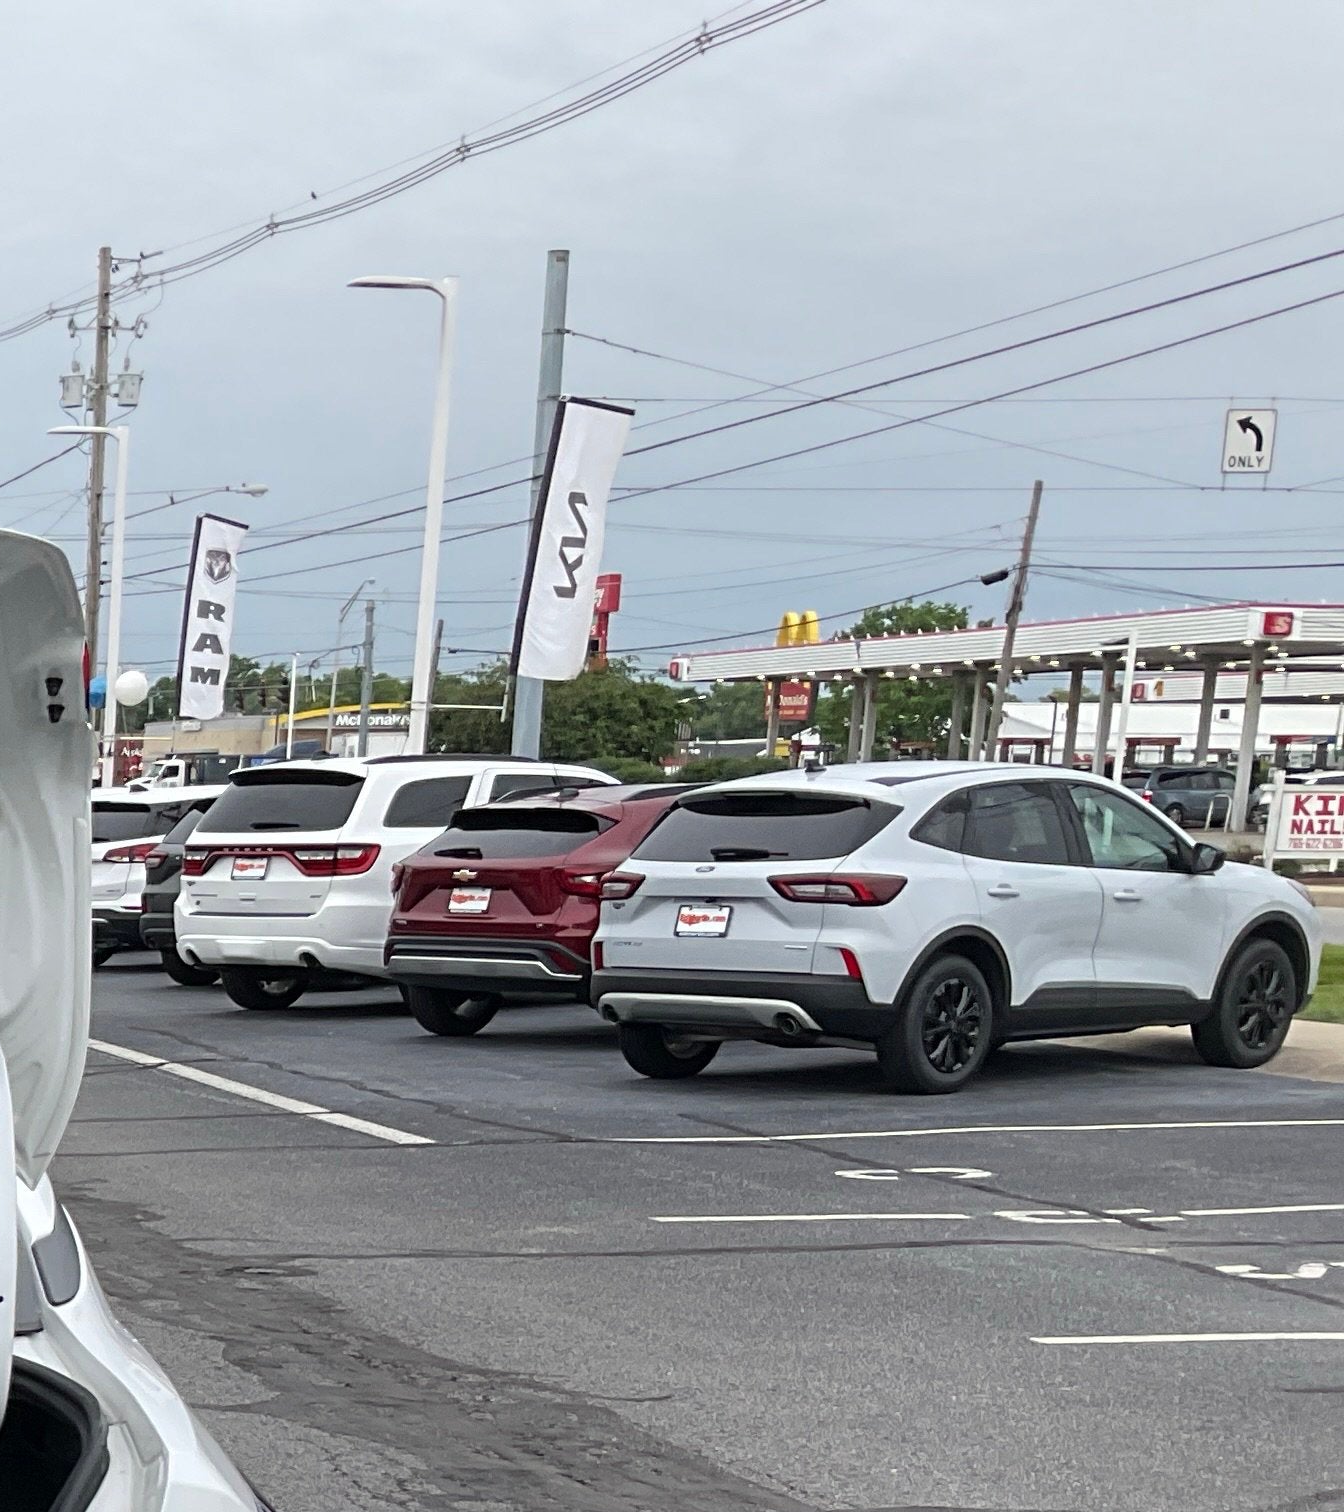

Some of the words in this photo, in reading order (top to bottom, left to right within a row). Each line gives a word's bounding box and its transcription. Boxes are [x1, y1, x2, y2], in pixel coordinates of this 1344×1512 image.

[1228, 455, 1265, 468] ONLY
[190, 600, 226, 686] RAM
[1290, 819, 1344, 835] NAIL
